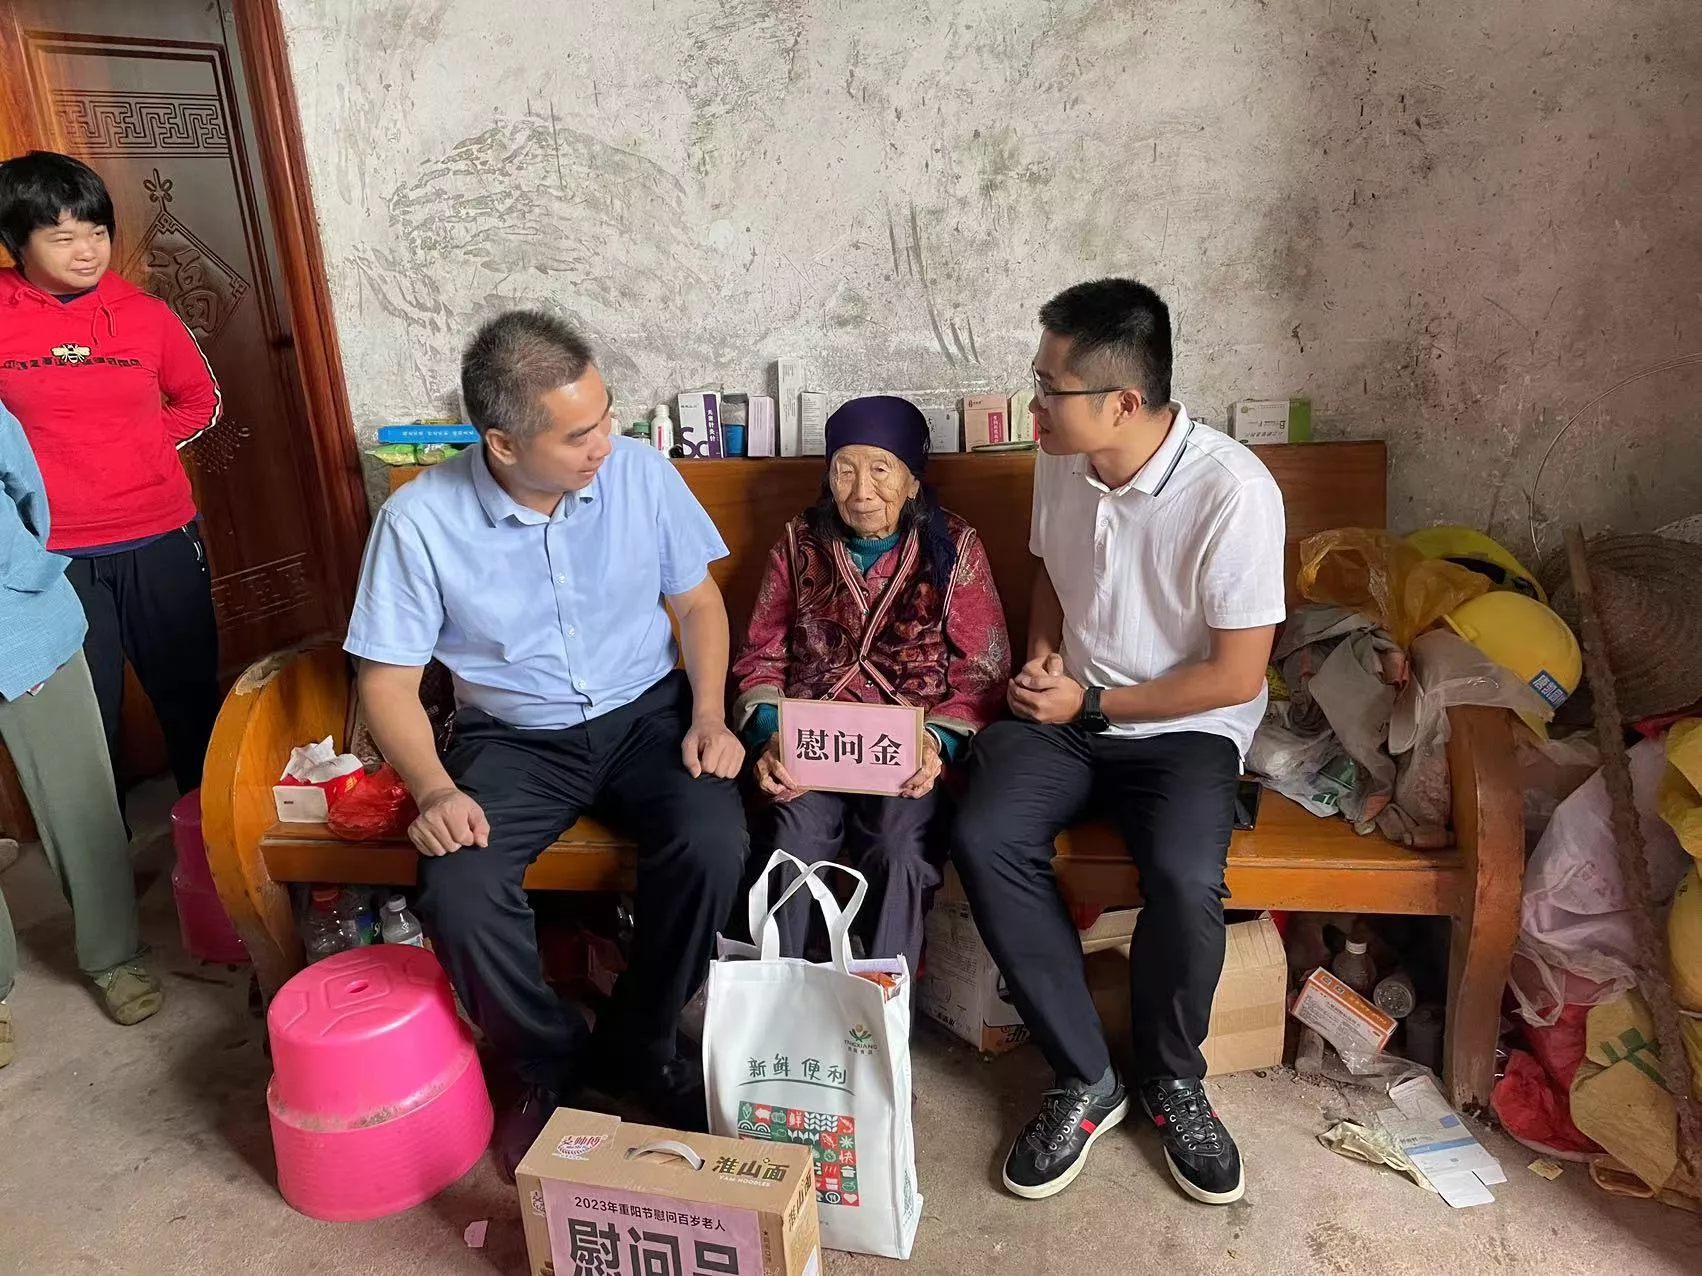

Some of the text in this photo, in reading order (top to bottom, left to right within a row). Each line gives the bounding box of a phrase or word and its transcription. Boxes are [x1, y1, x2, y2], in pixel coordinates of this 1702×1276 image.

[796, 728, 902, 766] 慰问金
[748, 1053, 847, 1085] 新鲜 便利
[712, 1156, 790, 1182] 淮山面
[574, 1196, 726, 1232] 2023年重阳节慰问百岁老人
